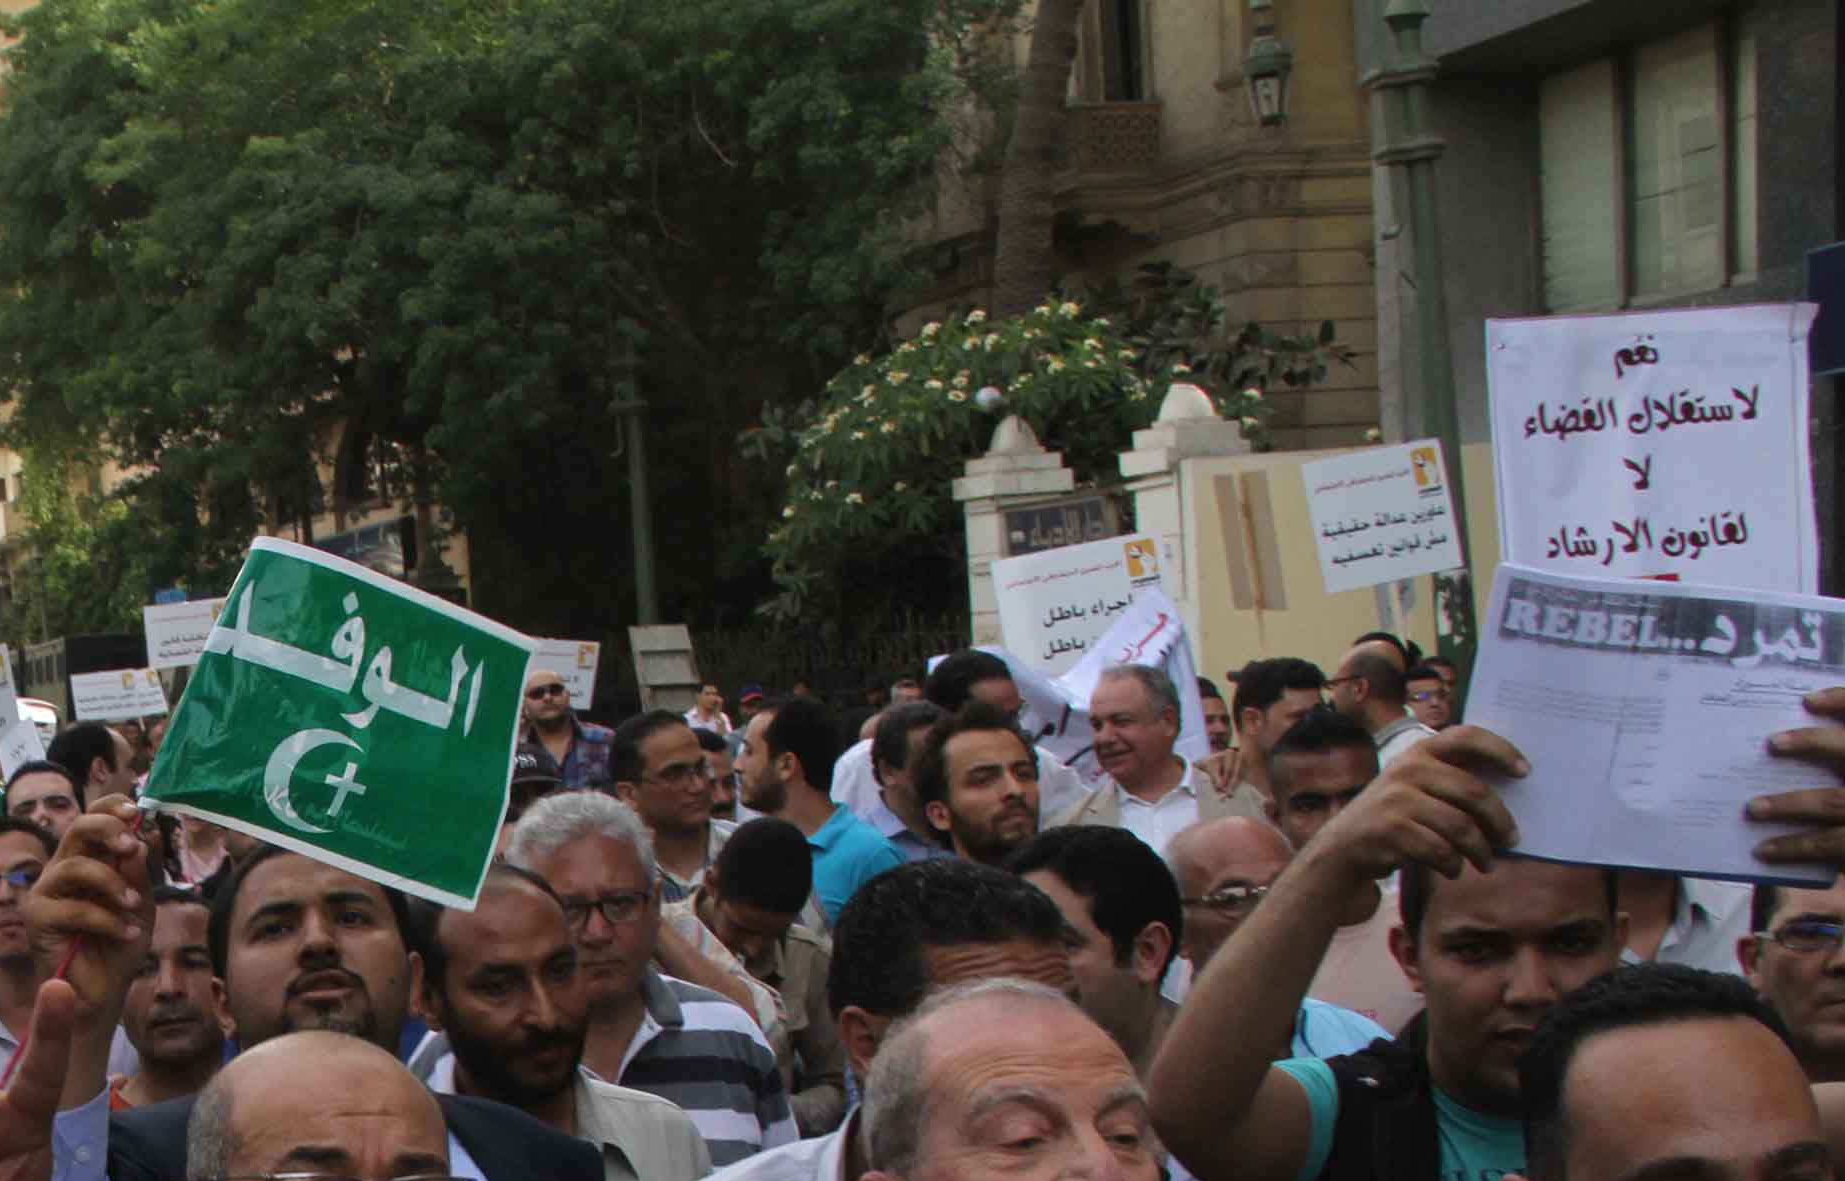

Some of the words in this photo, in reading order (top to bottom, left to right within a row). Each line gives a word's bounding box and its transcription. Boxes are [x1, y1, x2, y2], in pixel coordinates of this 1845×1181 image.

[1614, 335, 1658, 379] نعم
[1523, 398, 1618, 440] القضاء
[1628, 384, 1759, 435] لاستقلال
[1623, 454, 1652, 490] لا
[1660, 510, 1748, 560] لقانون
[1043, 605, 1085, 628] باطل
[204, 578, 485, 739] الوفد
[1043, 637, 1085, 660] باطل
